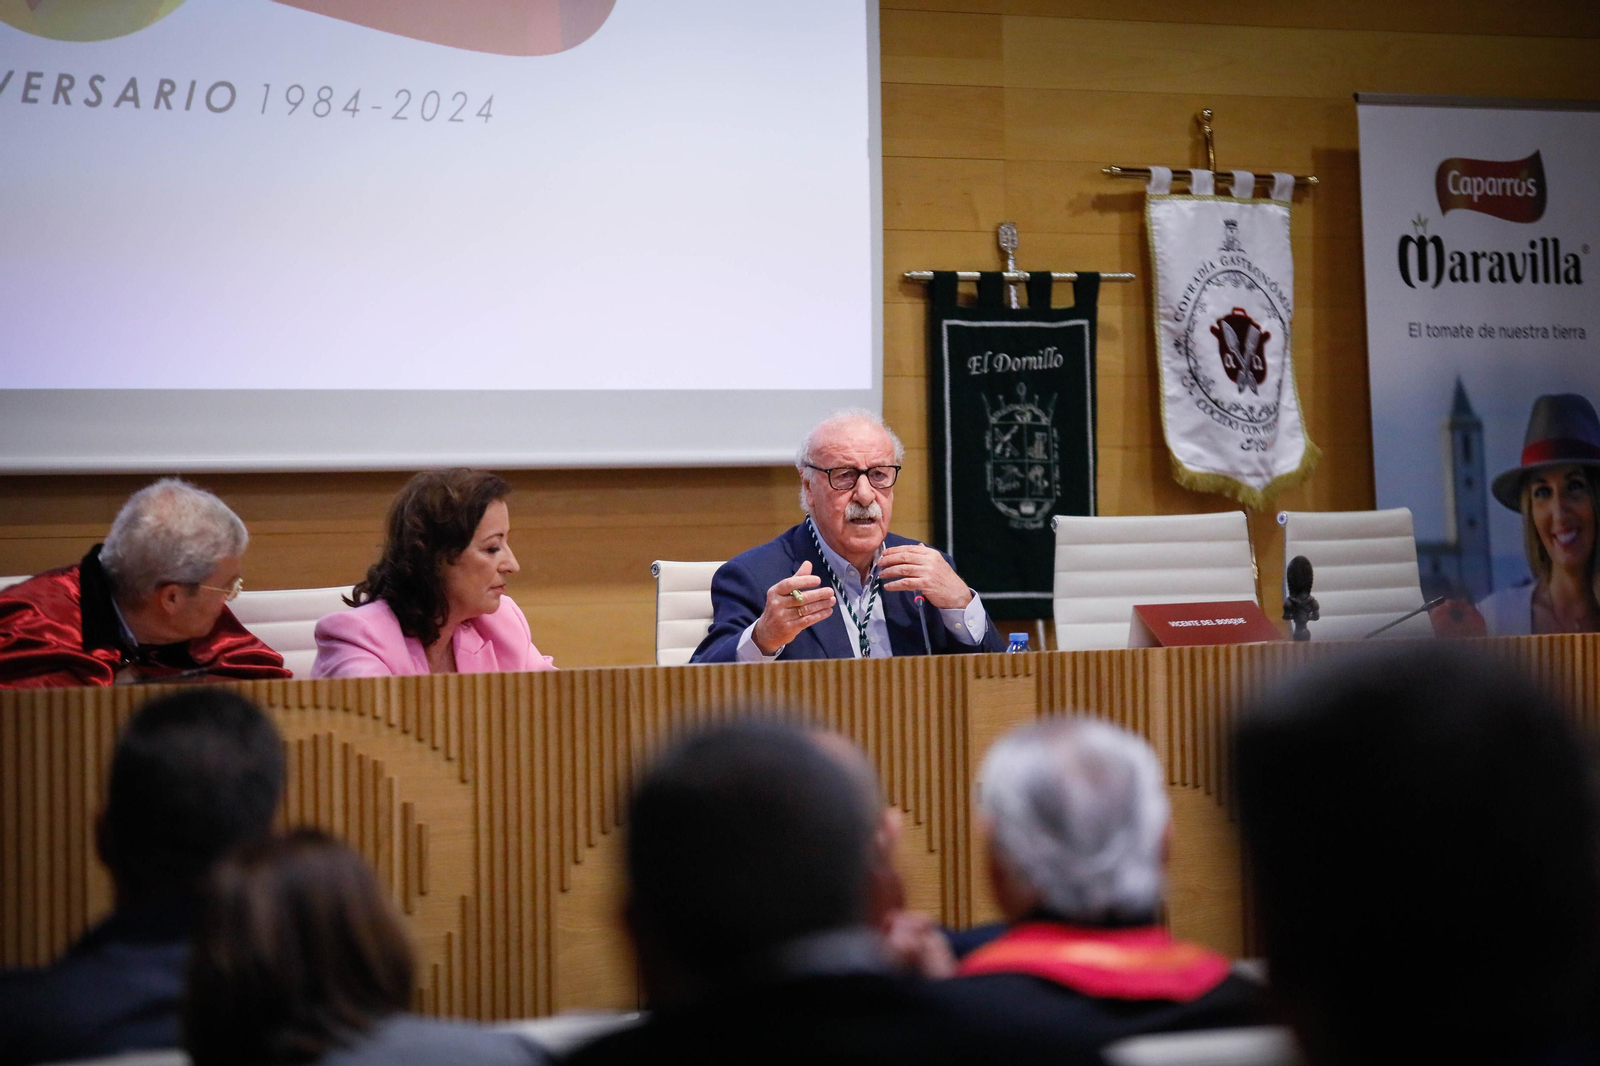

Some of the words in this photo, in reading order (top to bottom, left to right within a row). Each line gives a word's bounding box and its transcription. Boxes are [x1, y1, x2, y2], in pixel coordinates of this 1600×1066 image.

[260, 83, 495, 124] 1984-2024
[1408, 321, 1422, 339] El
[1425, 323, 1475, 340] tomate
[1478, 322, 1496, 340] de
[1499, 324, 1549, 341] nuestra
[1552, 324, 1587, 341] tierra
[967, 351, 993, 375] El
